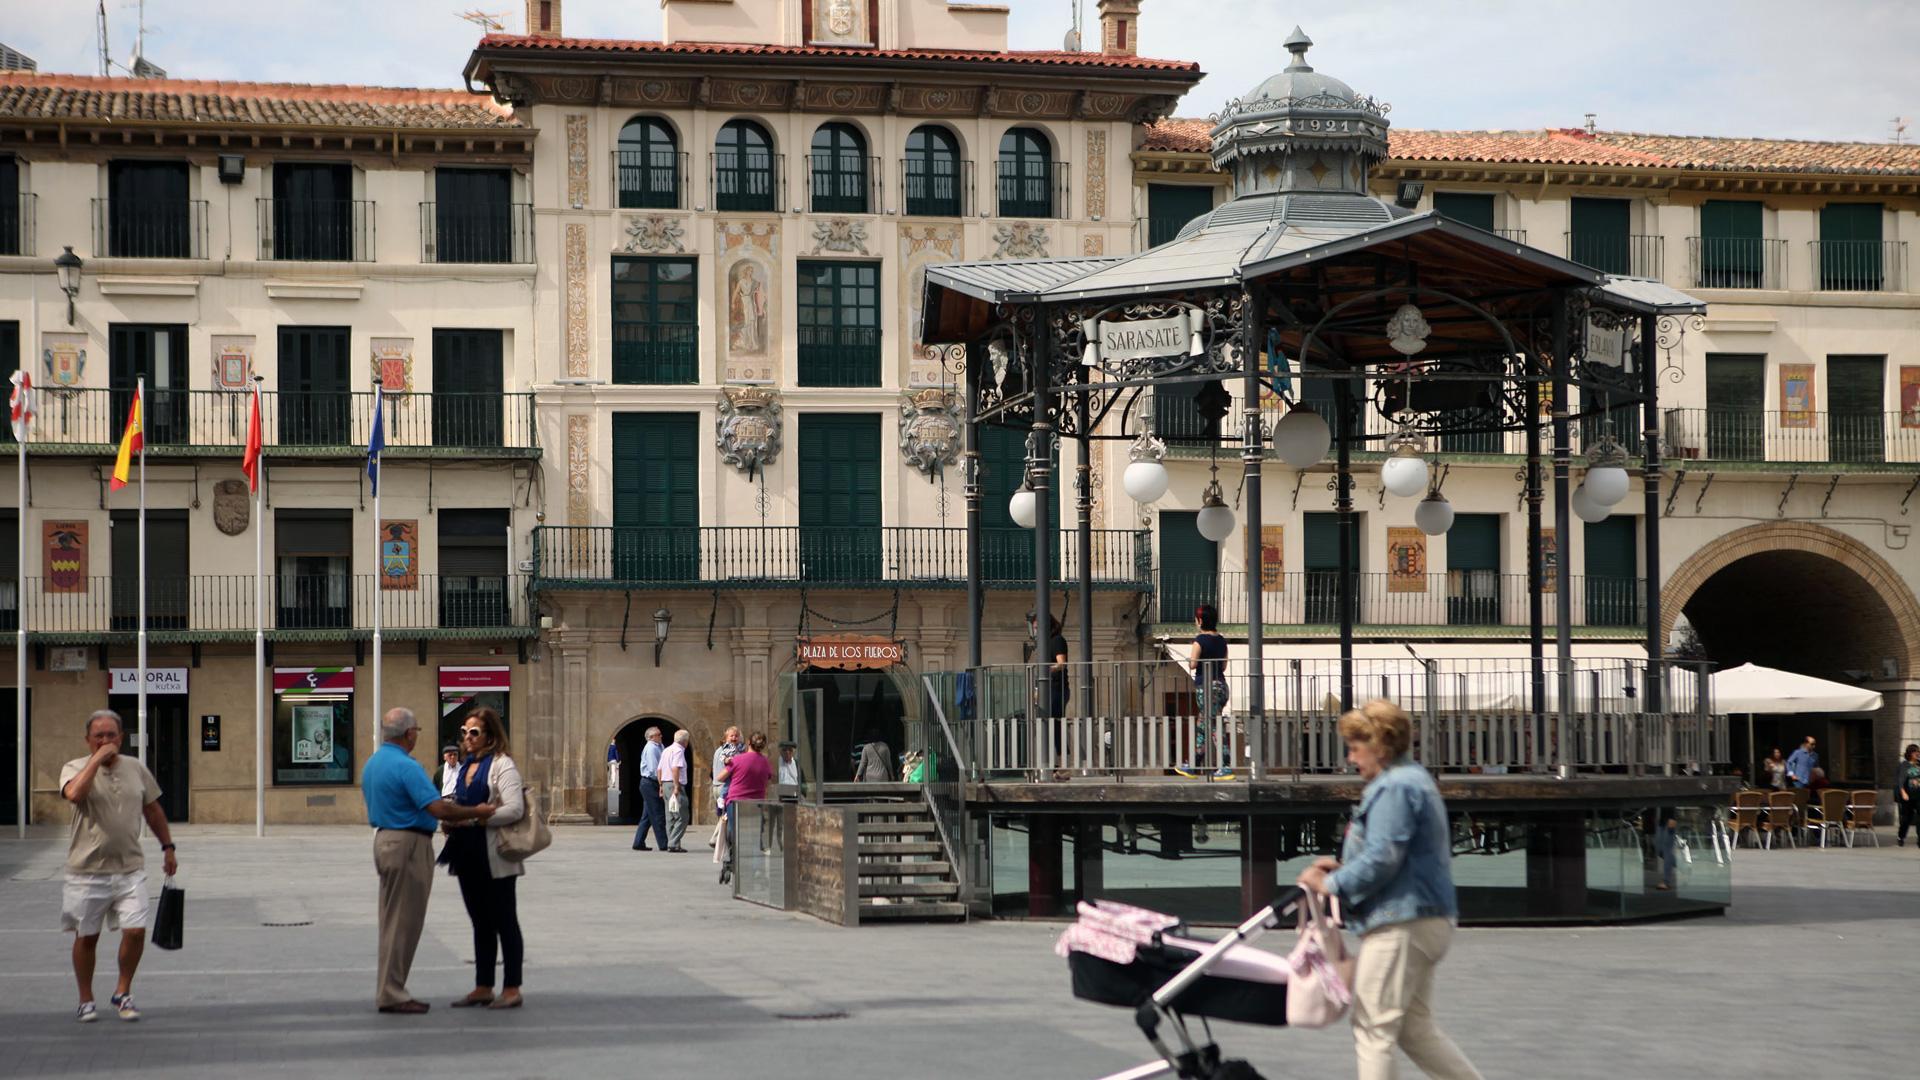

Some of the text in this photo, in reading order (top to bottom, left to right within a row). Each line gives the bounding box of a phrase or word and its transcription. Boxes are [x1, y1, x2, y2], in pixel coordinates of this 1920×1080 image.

[1297, 119, 1350, 132] 1921
[1107, 327, 1182, 351] SARASATE
[803, 646, 898, 658] PLAZA DE LOS FUEROS
[120, 672, 180, 682] LAORAL
